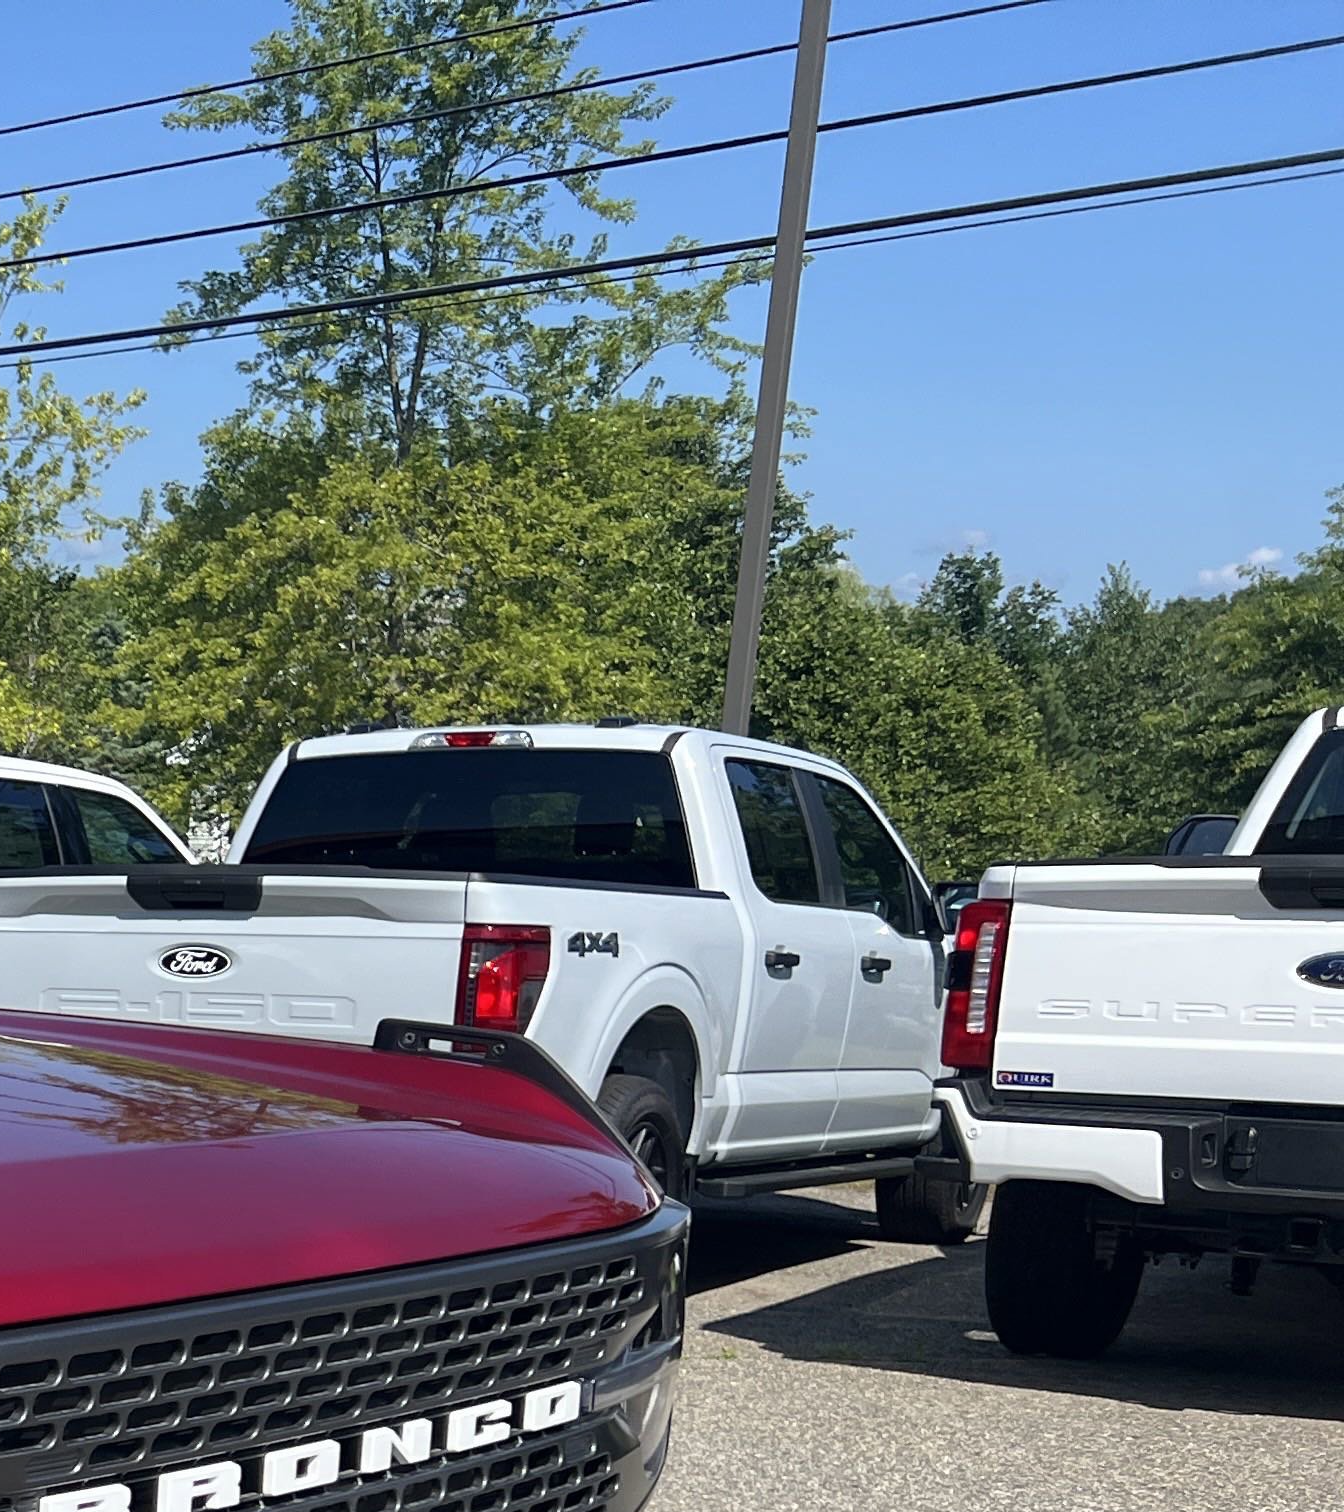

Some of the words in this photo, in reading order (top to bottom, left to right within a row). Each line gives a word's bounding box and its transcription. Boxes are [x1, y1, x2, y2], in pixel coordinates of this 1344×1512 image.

[170, 950, 219, 973] Ford
[39, 987, 357, 1029] F-150
[998, 1072, 1052, 1084] QUIRK
